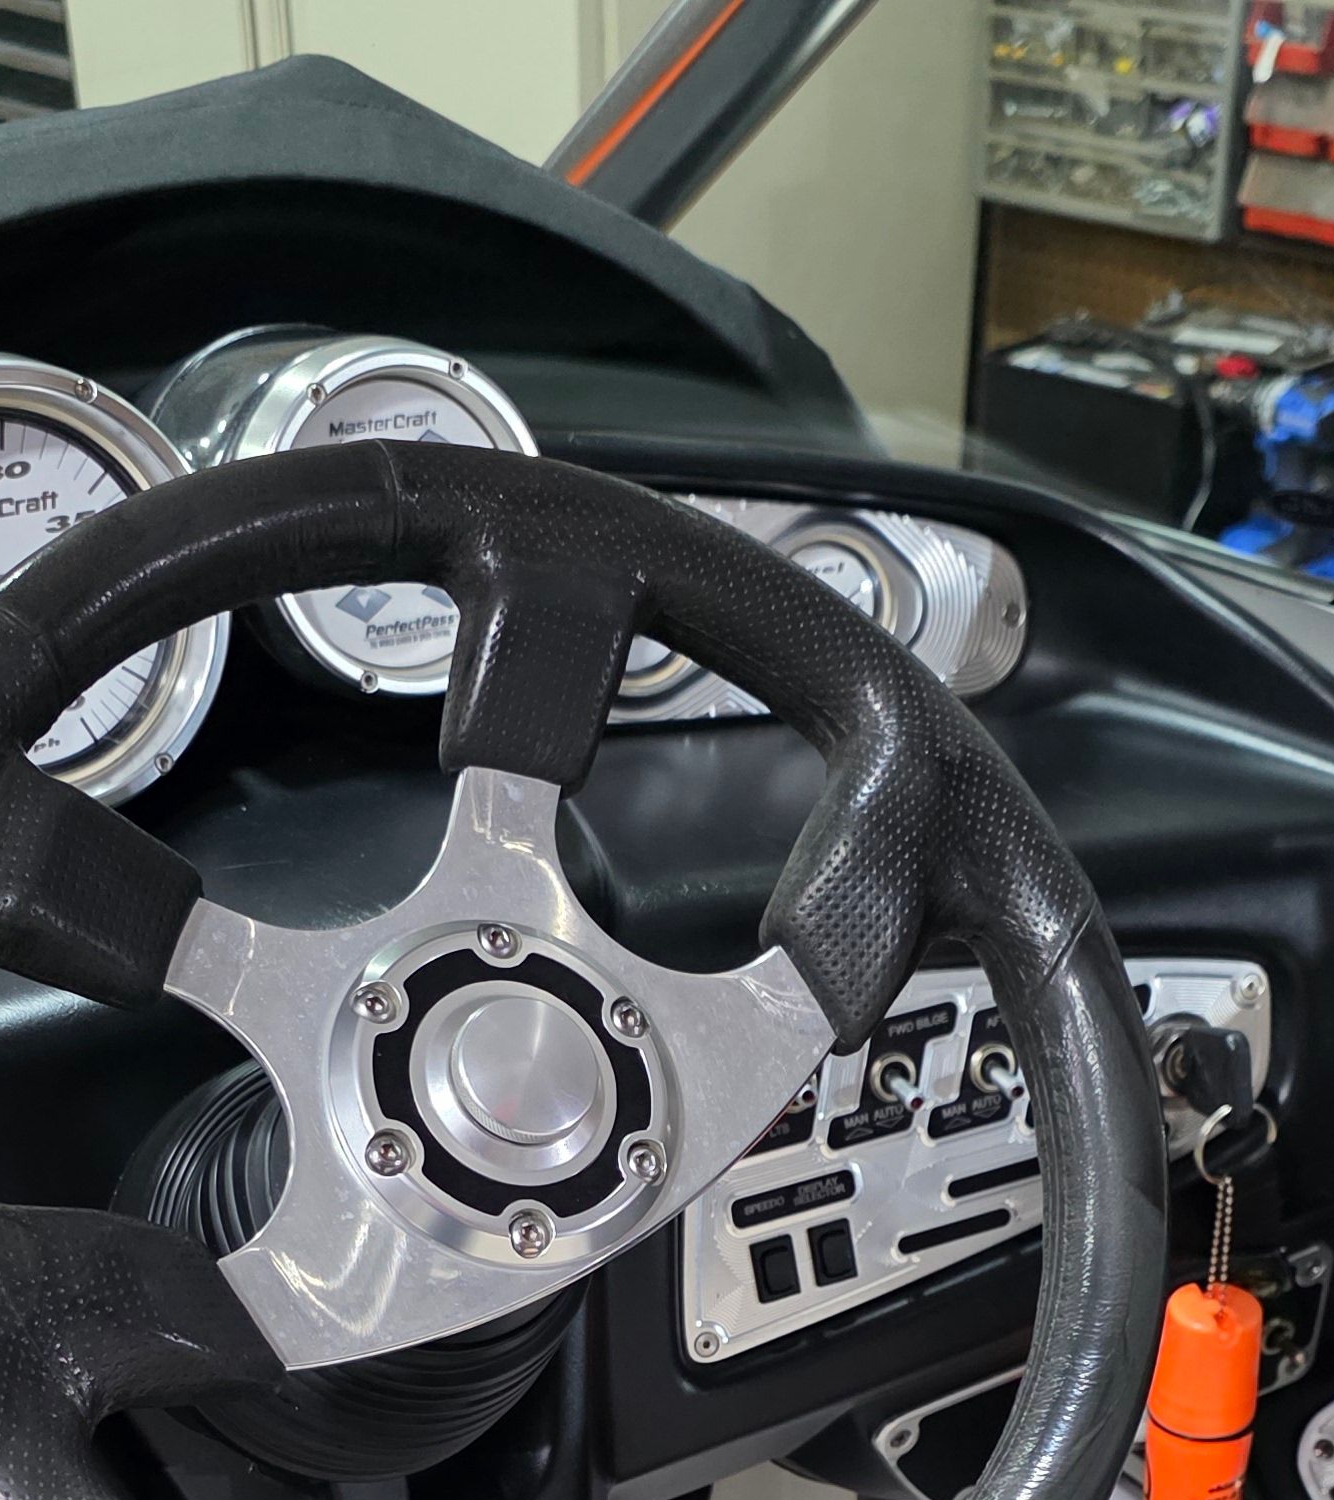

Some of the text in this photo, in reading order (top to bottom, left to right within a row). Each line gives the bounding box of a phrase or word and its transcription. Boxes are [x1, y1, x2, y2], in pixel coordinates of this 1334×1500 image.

[329, 410, 437, 437] MasterCraft
[874, 1105, 904, 1120] AUTO
[942, 1095, 1002, 1119] MAN AUTO
